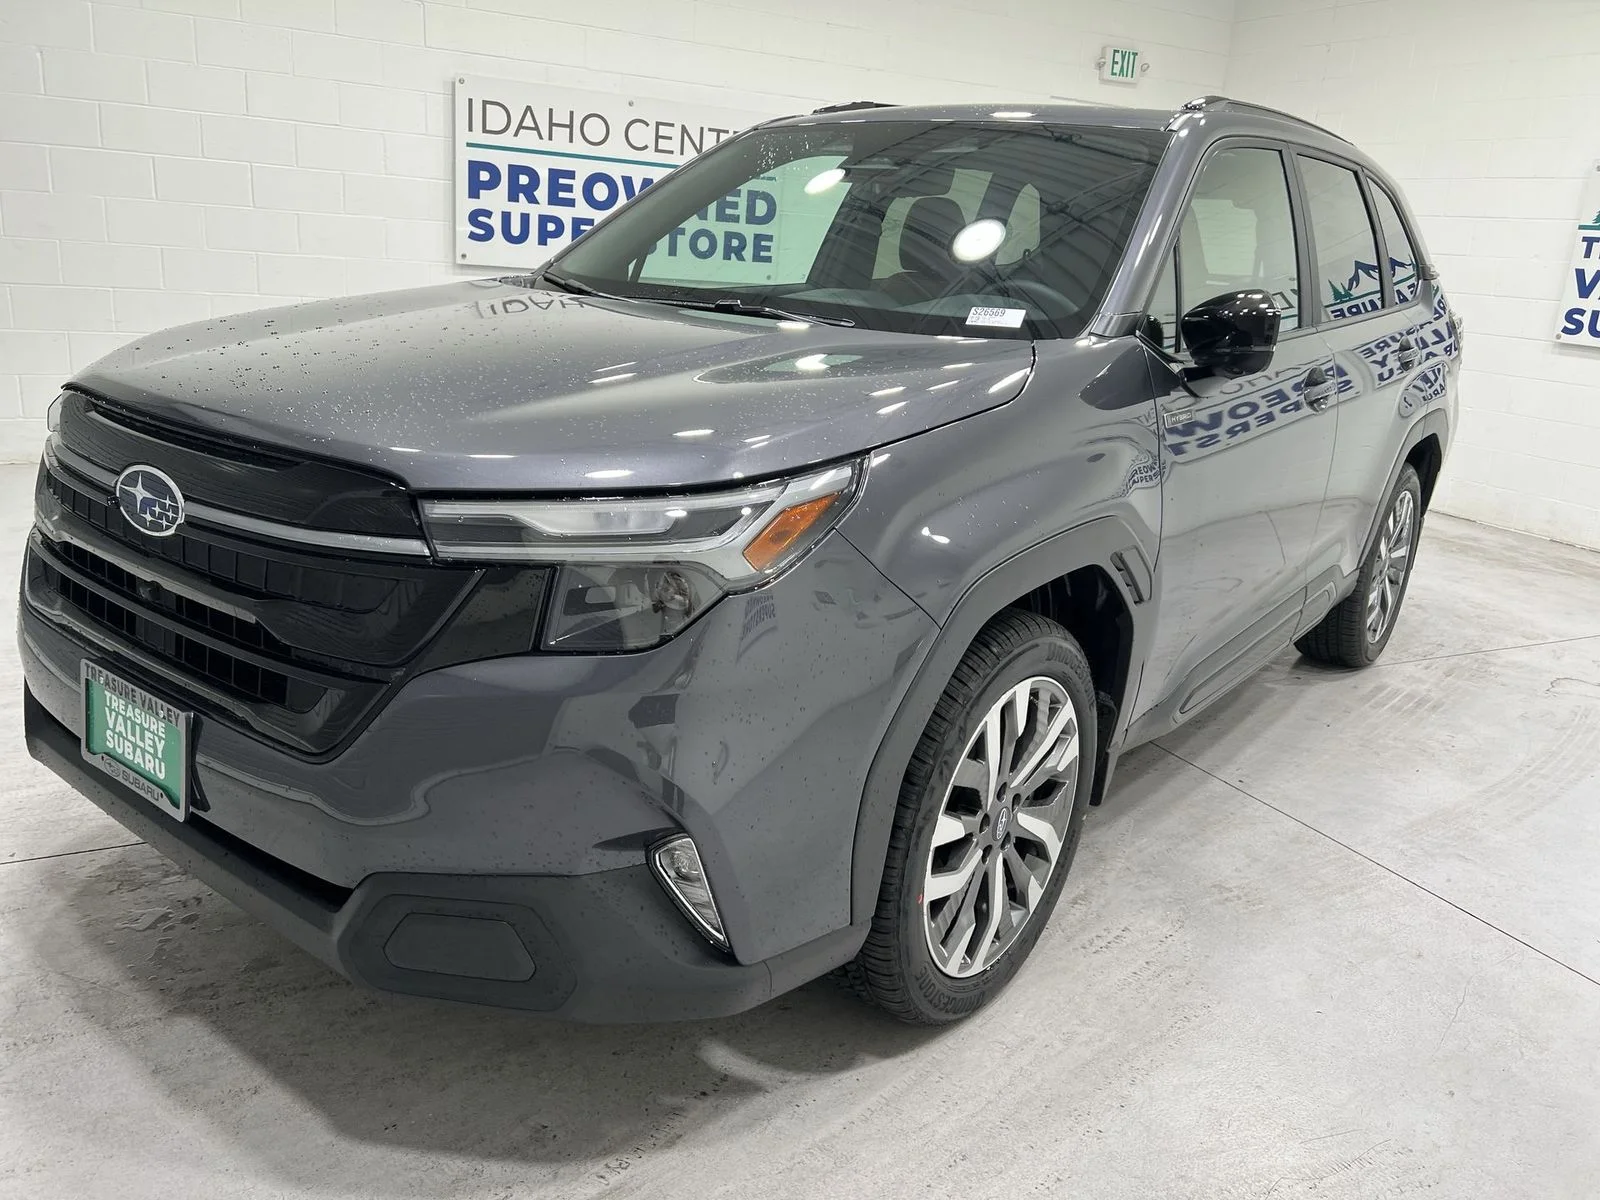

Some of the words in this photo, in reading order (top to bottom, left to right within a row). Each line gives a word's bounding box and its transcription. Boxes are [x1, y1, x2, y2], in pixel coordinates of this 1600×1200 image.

[1110, 49, 1138, 78] EXIT
[466, 97, 611, 147] IDAHO
[623, 117, 746, 156] CENT
[1581, 236, 1600, 259] T
[1575, 268, 1600, 299] V
[972, 307, 1006, 317] S26569
[85, 662, 137, 703] TREASURE
[139, 692, 181, 726] VALLEY
[104, 690, 165, 739] TREASURE
[104, 707, 165, 758] VALLEY
[106, 730, 165, 780] SUBARU
[121, 771, 159, 802] SUBARU
